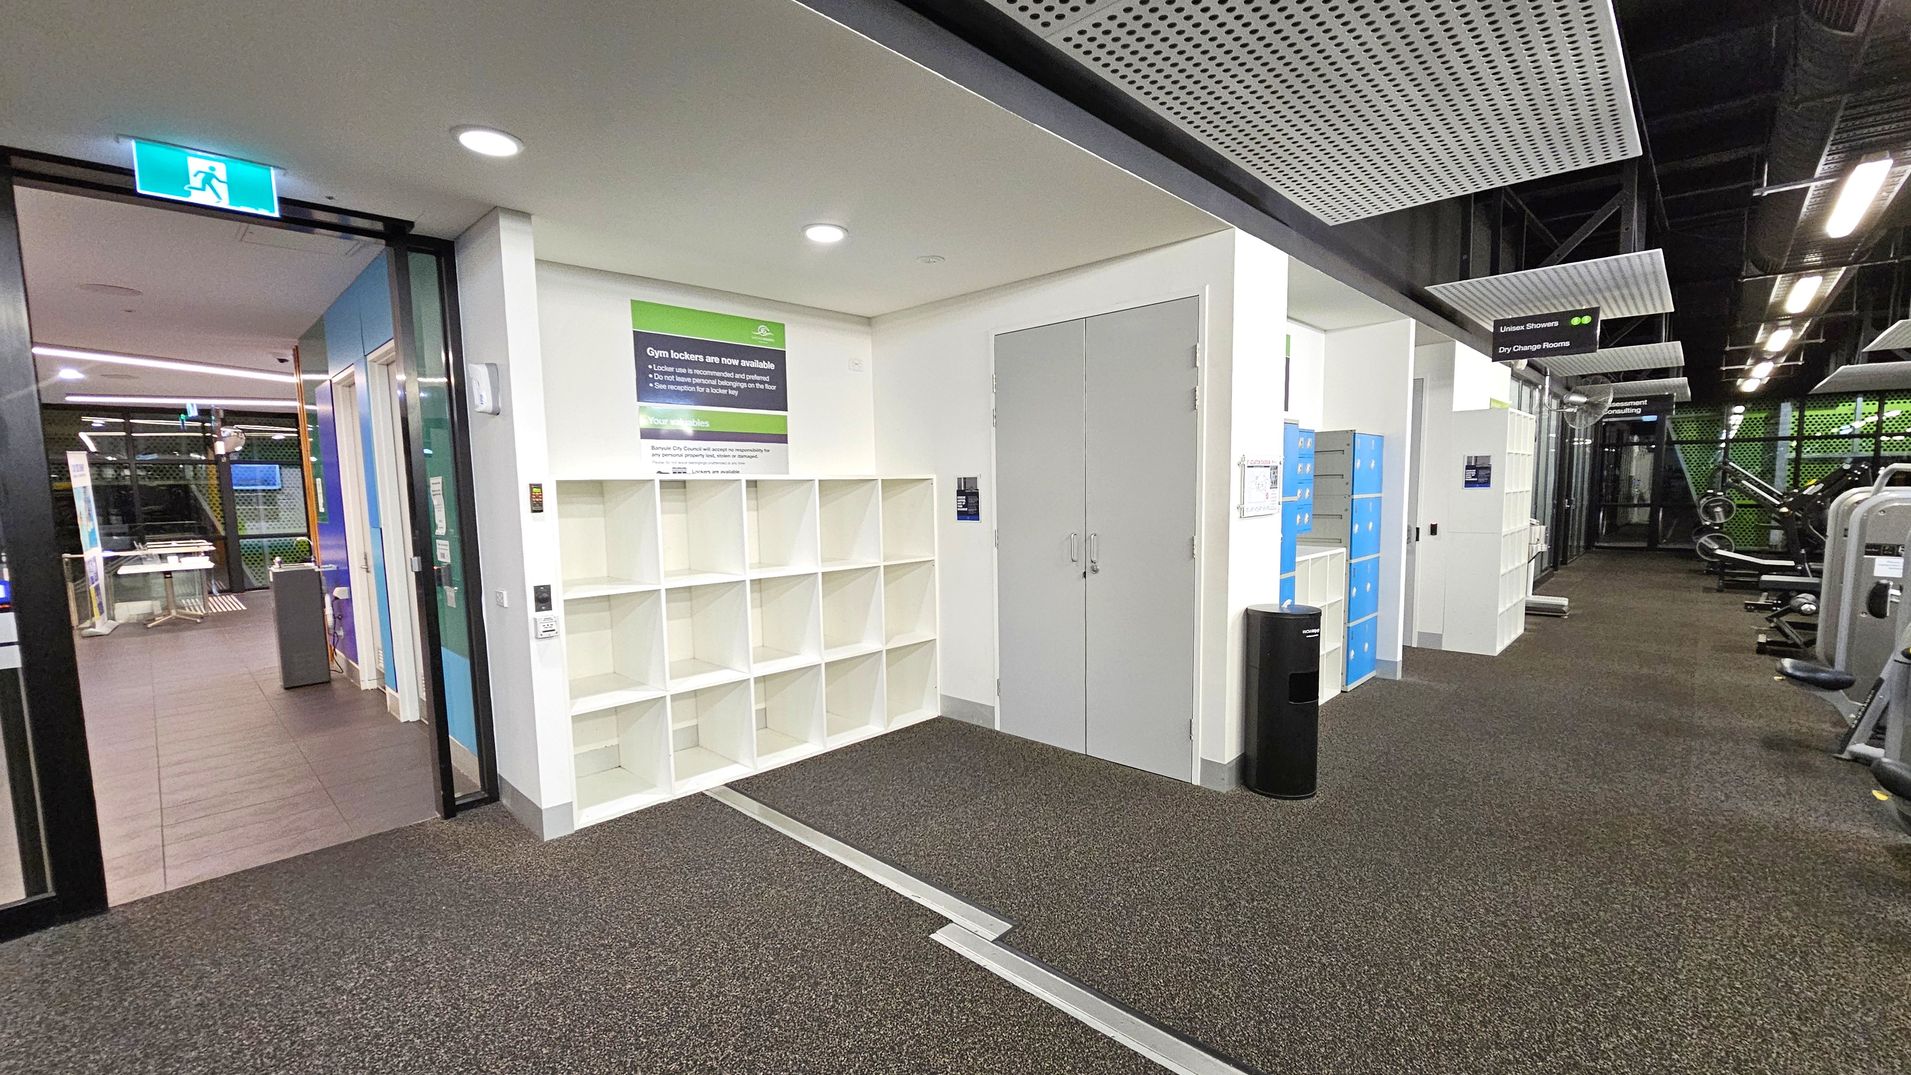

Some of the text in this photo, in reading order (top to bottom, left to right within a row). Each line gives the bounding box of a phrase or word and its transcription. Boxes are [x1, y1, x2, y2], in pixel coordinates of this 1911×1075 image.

[1526, 320, 1559, 329] Showers
[1542, 340, 1570, 348] Rooms
[647, 347, 669, 358] Gym
[670, 350, 704, 362] lockers
[741, 359, 775, 370] available
[694, 369, 734, 378] recommended
[718, 379, 747, 388] belongings
[648, 416, 668, 424] Your
